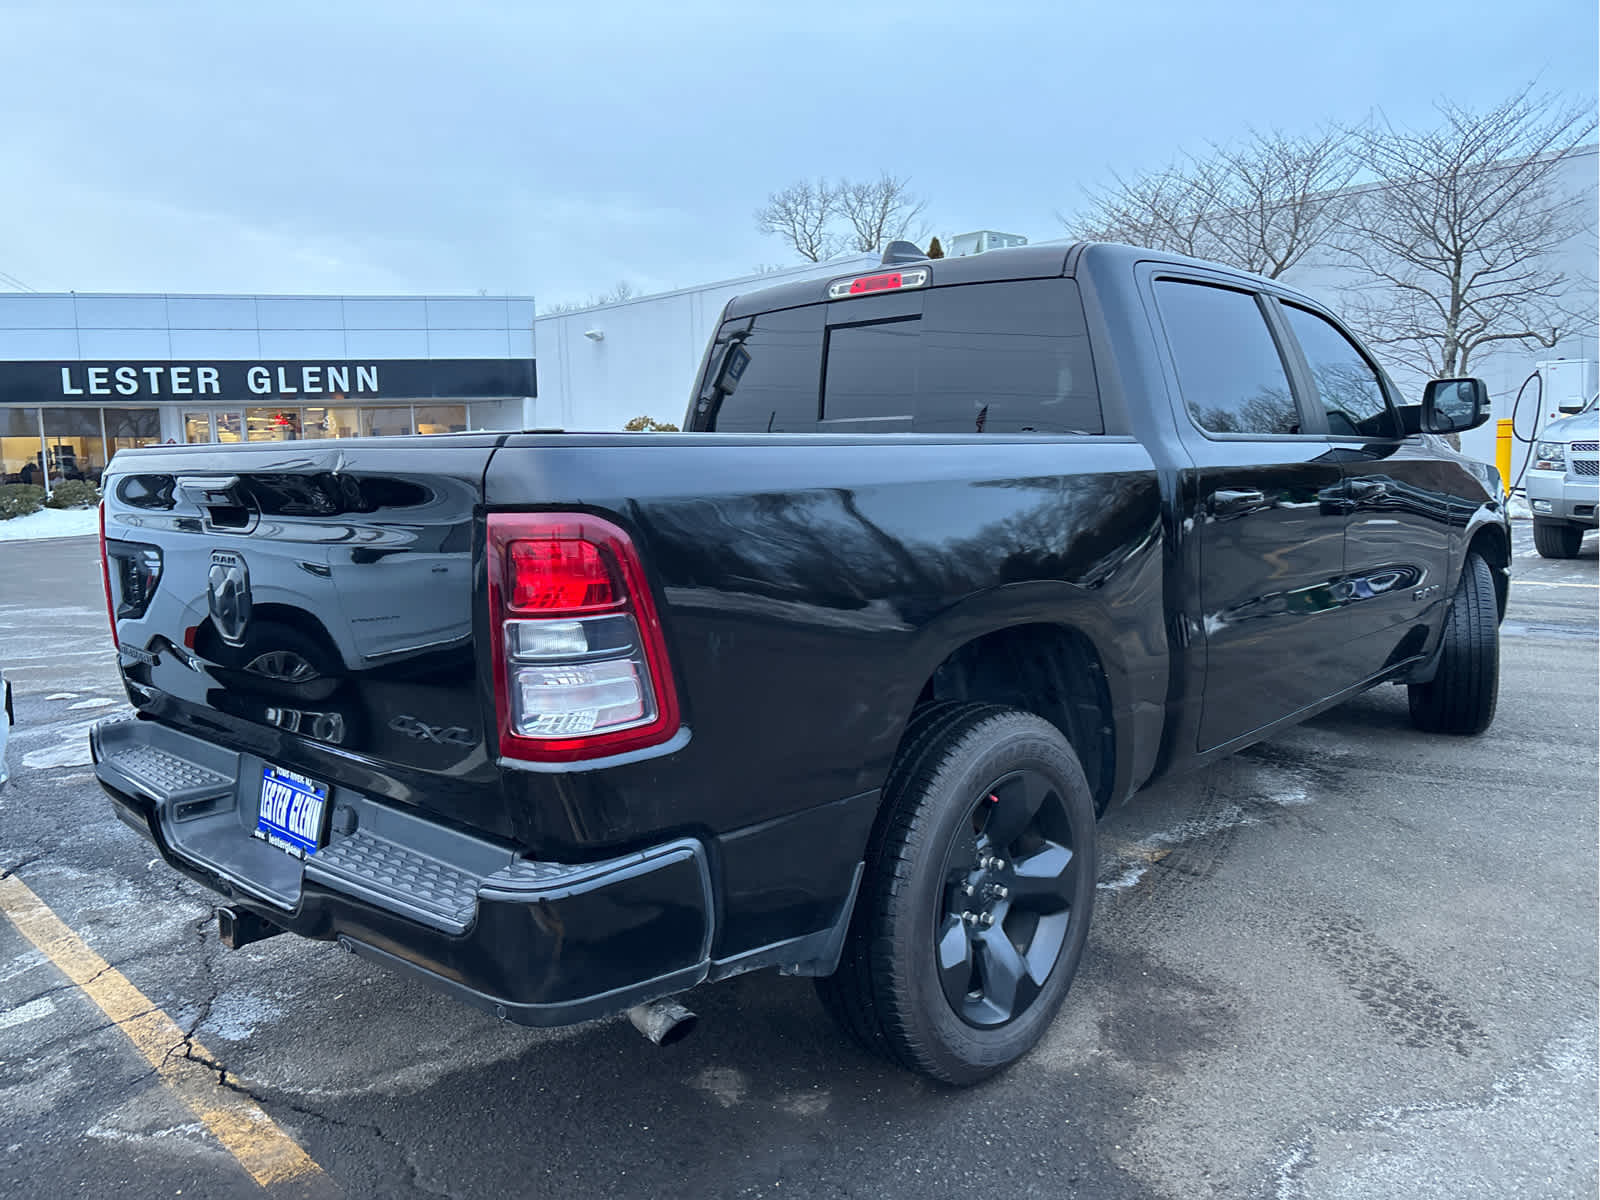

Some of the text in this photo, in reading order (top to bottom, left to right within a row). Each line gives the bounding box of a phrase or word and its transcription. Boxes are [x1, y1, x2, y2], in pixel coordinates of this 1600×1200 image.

[61, 366, 378, 395] LESTER GLENN
[212, 555, 236, 564] RAM
[1413, 585, 1440, 601] RAM
[260, 779, 323, 842] LESTER GLENN
